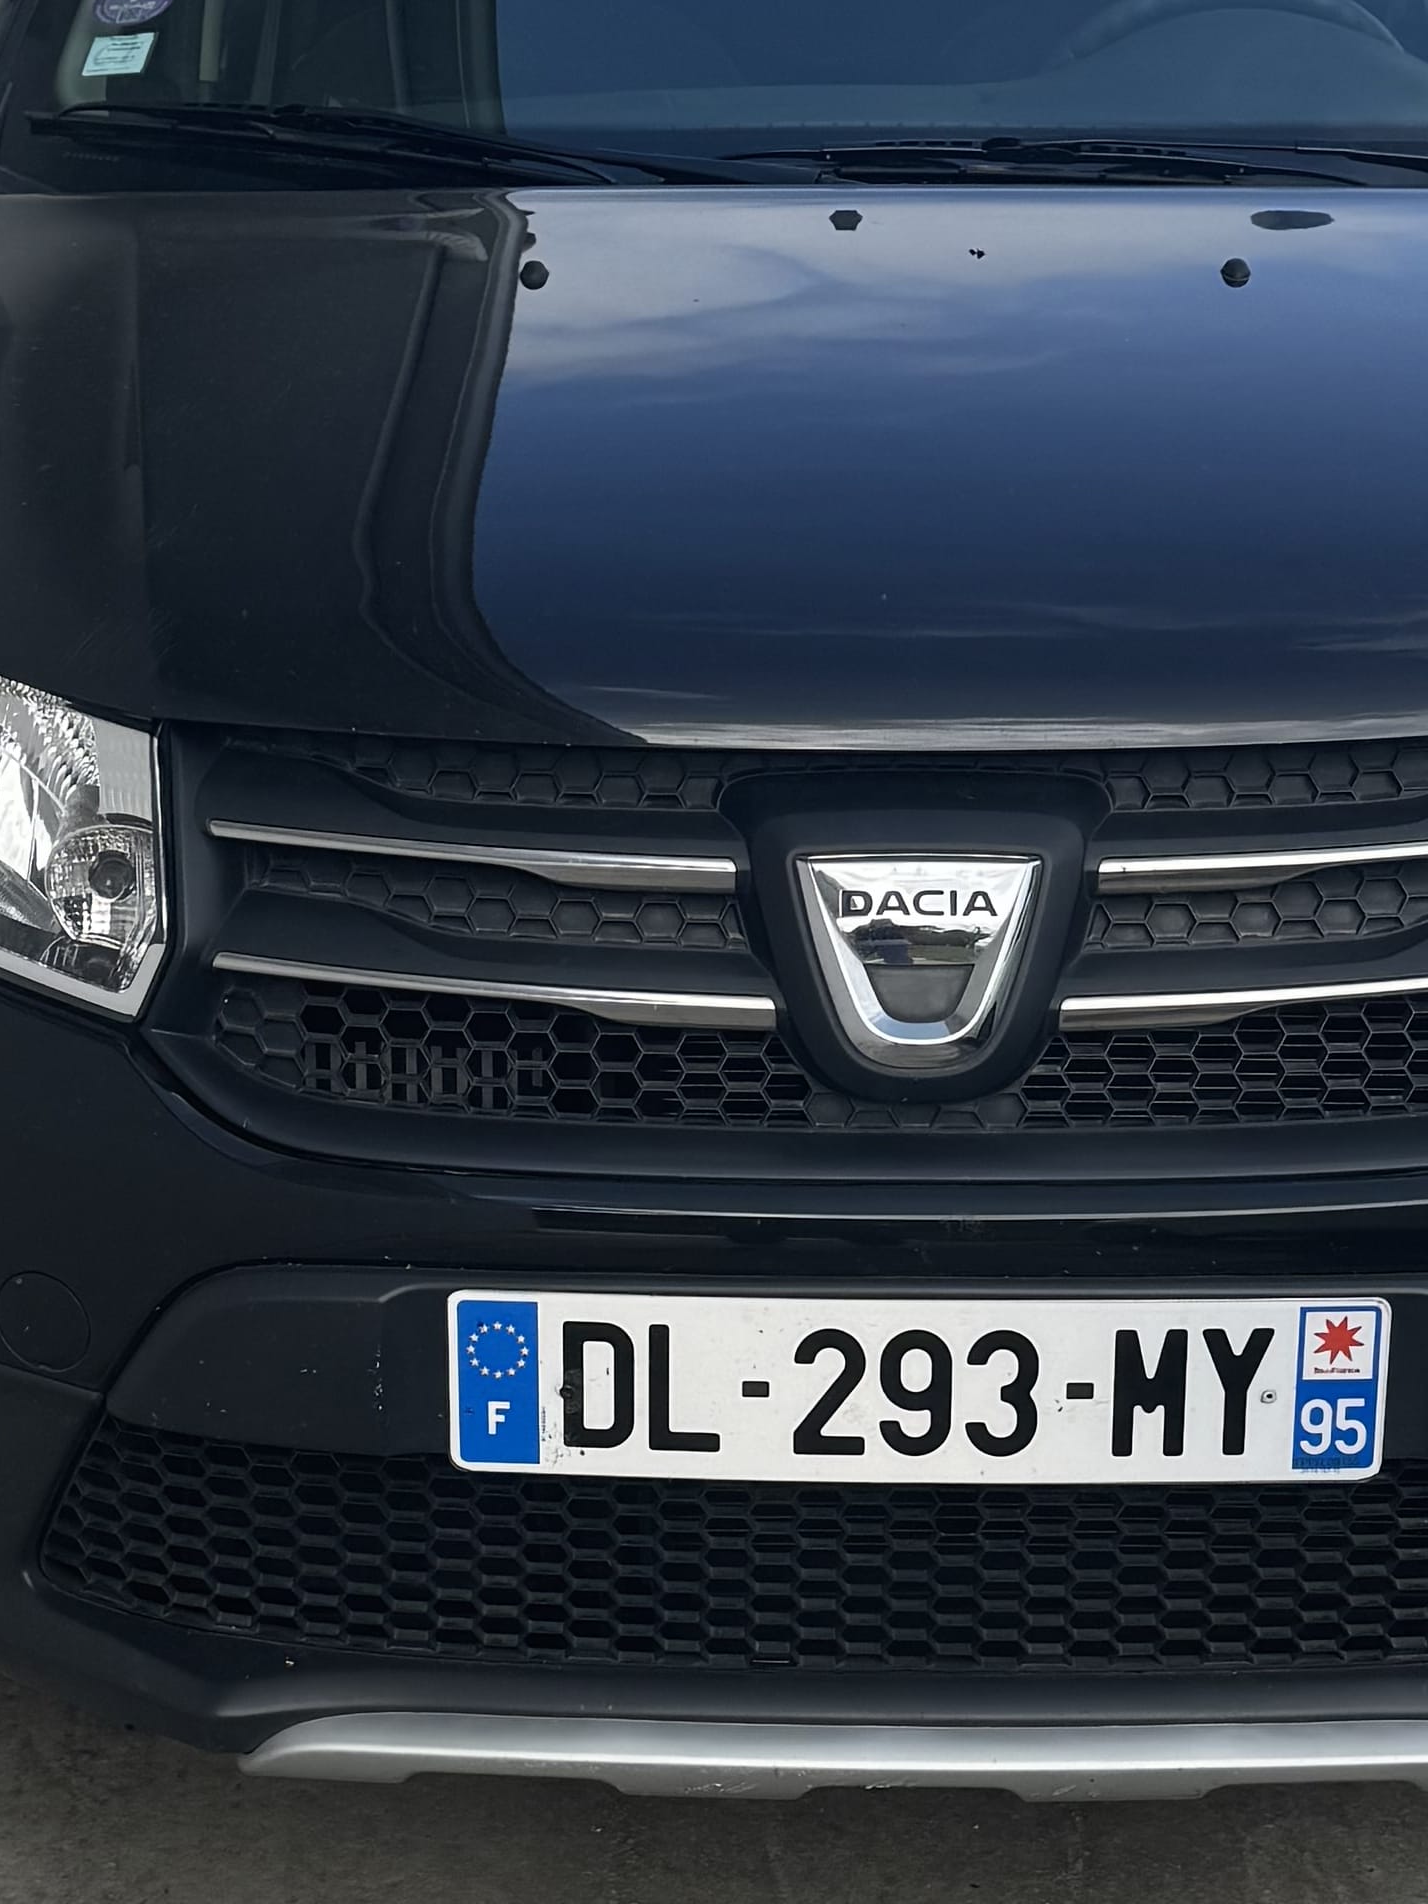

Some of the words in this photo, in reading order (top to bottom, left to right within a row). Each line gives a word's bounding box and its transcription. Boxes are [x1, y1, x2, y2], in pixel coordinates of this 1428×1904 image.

[839, 890, 998, 917] DACIA
[560, 1321, 1275, 1456] DL-293-MY
[487, 1401, 511, 1435] F
[1300, 1398, 1367, 1455] 95
